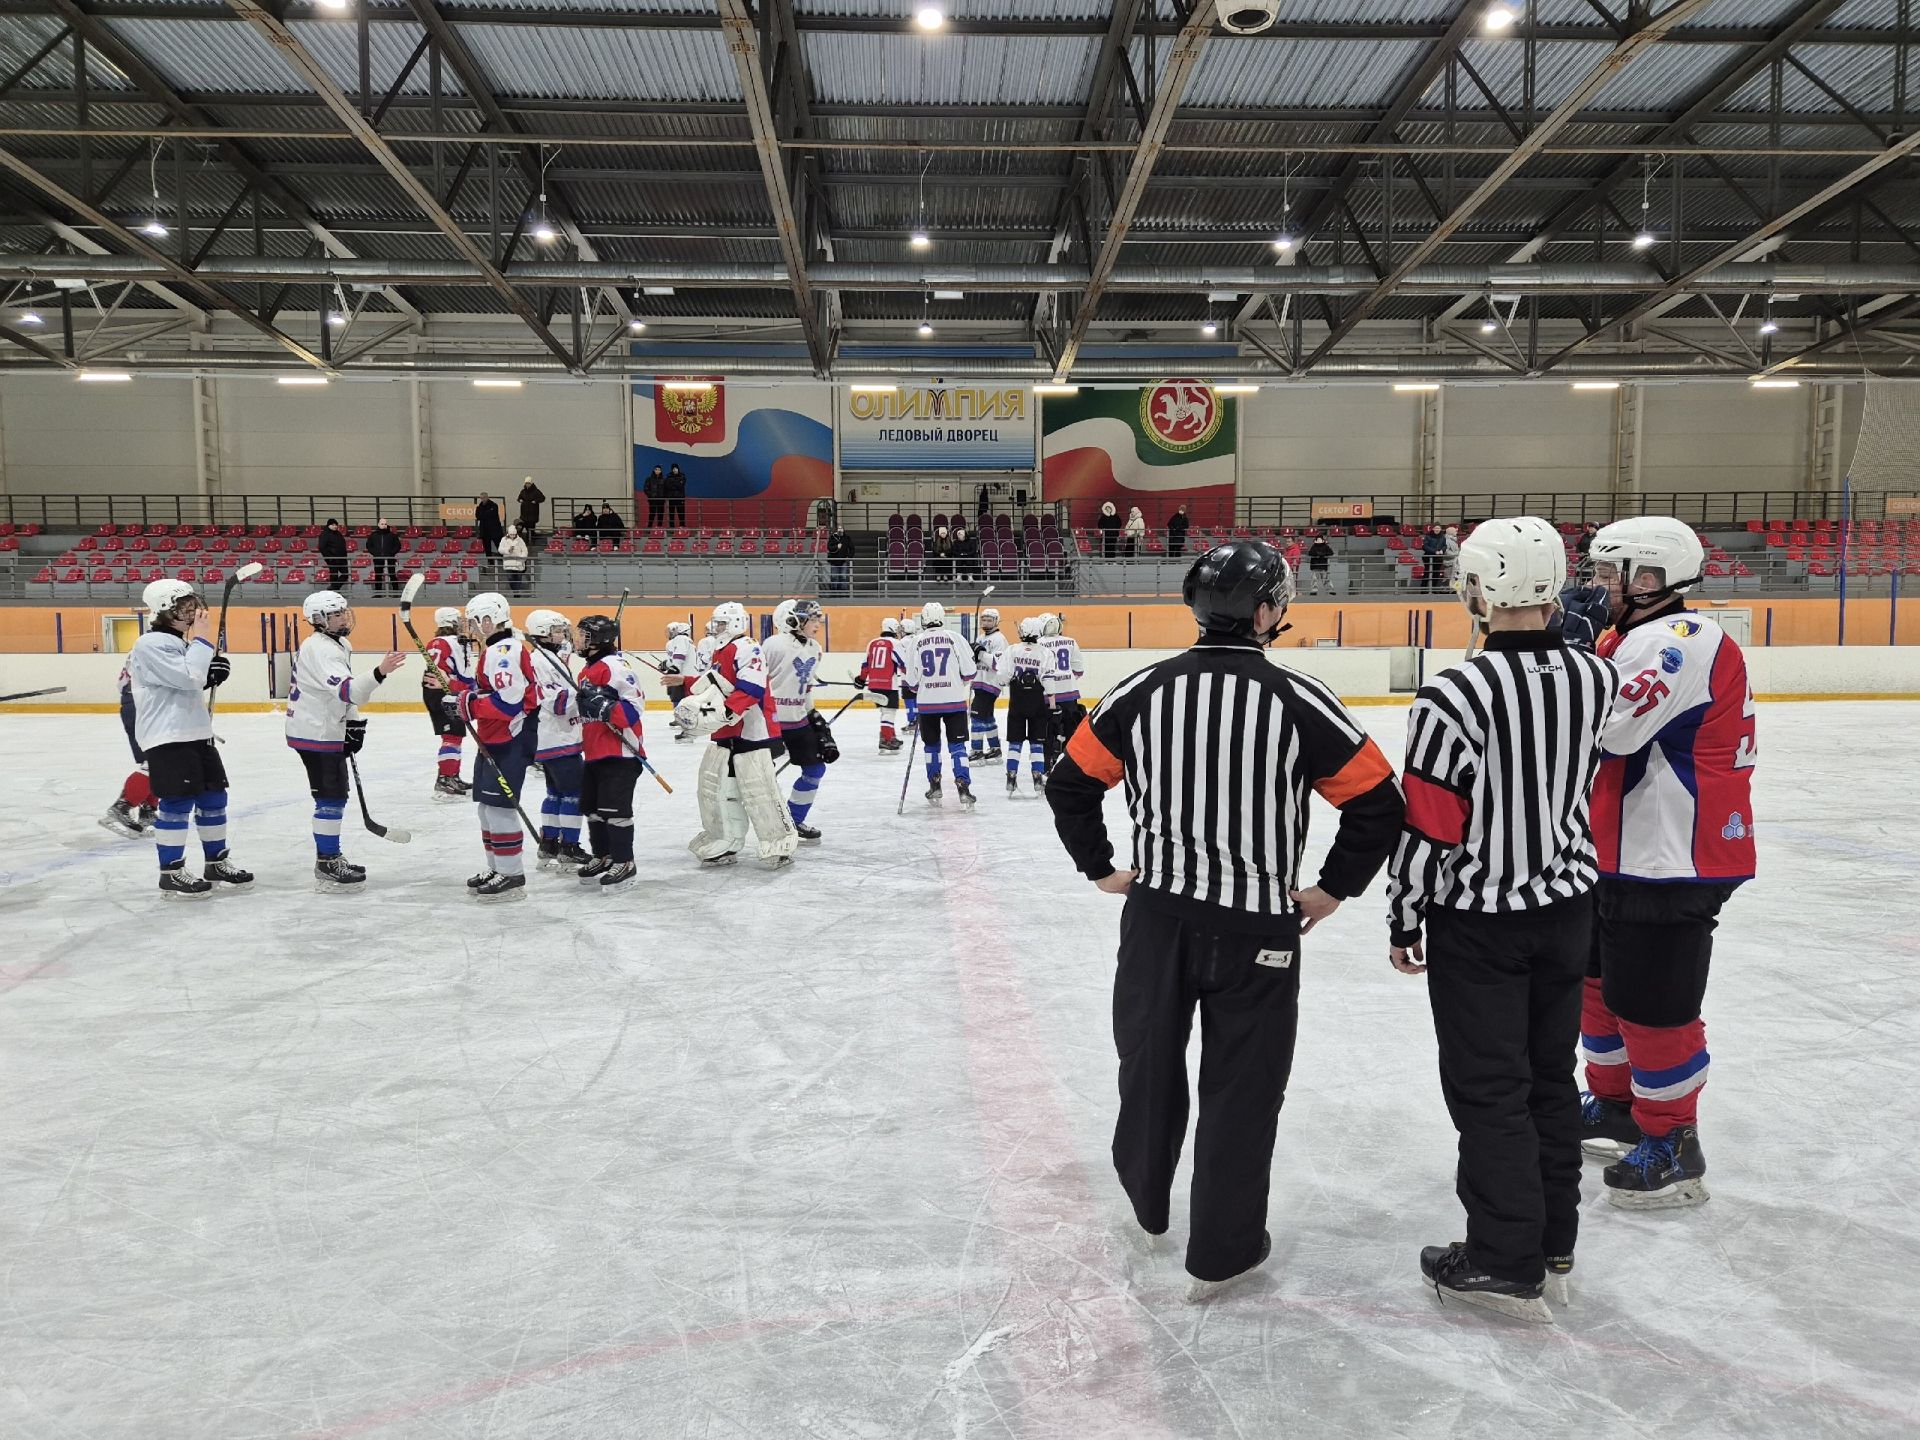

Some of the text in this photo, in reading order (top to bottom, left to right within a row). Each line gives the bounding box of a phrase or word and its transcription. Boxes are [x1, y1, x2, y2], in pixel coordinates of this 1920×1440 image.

[851, 388, 1025, 418] ОЛИМПИЯ
[879, 427, 998, 442] ЛЕДОВЫЙ ДВОРЕЦ
[447, 507, 477, 515] СЕКТО
[1319, 506, 1349, 514] СЕКТОР
[871, 647, 887, 669] 10
[921, 648, 951, 677] 97
[1527, 665, 1563, 674] LUTCH
[495, 671, 512, 690] 87
[1619, 669, 1670, 718] 55
